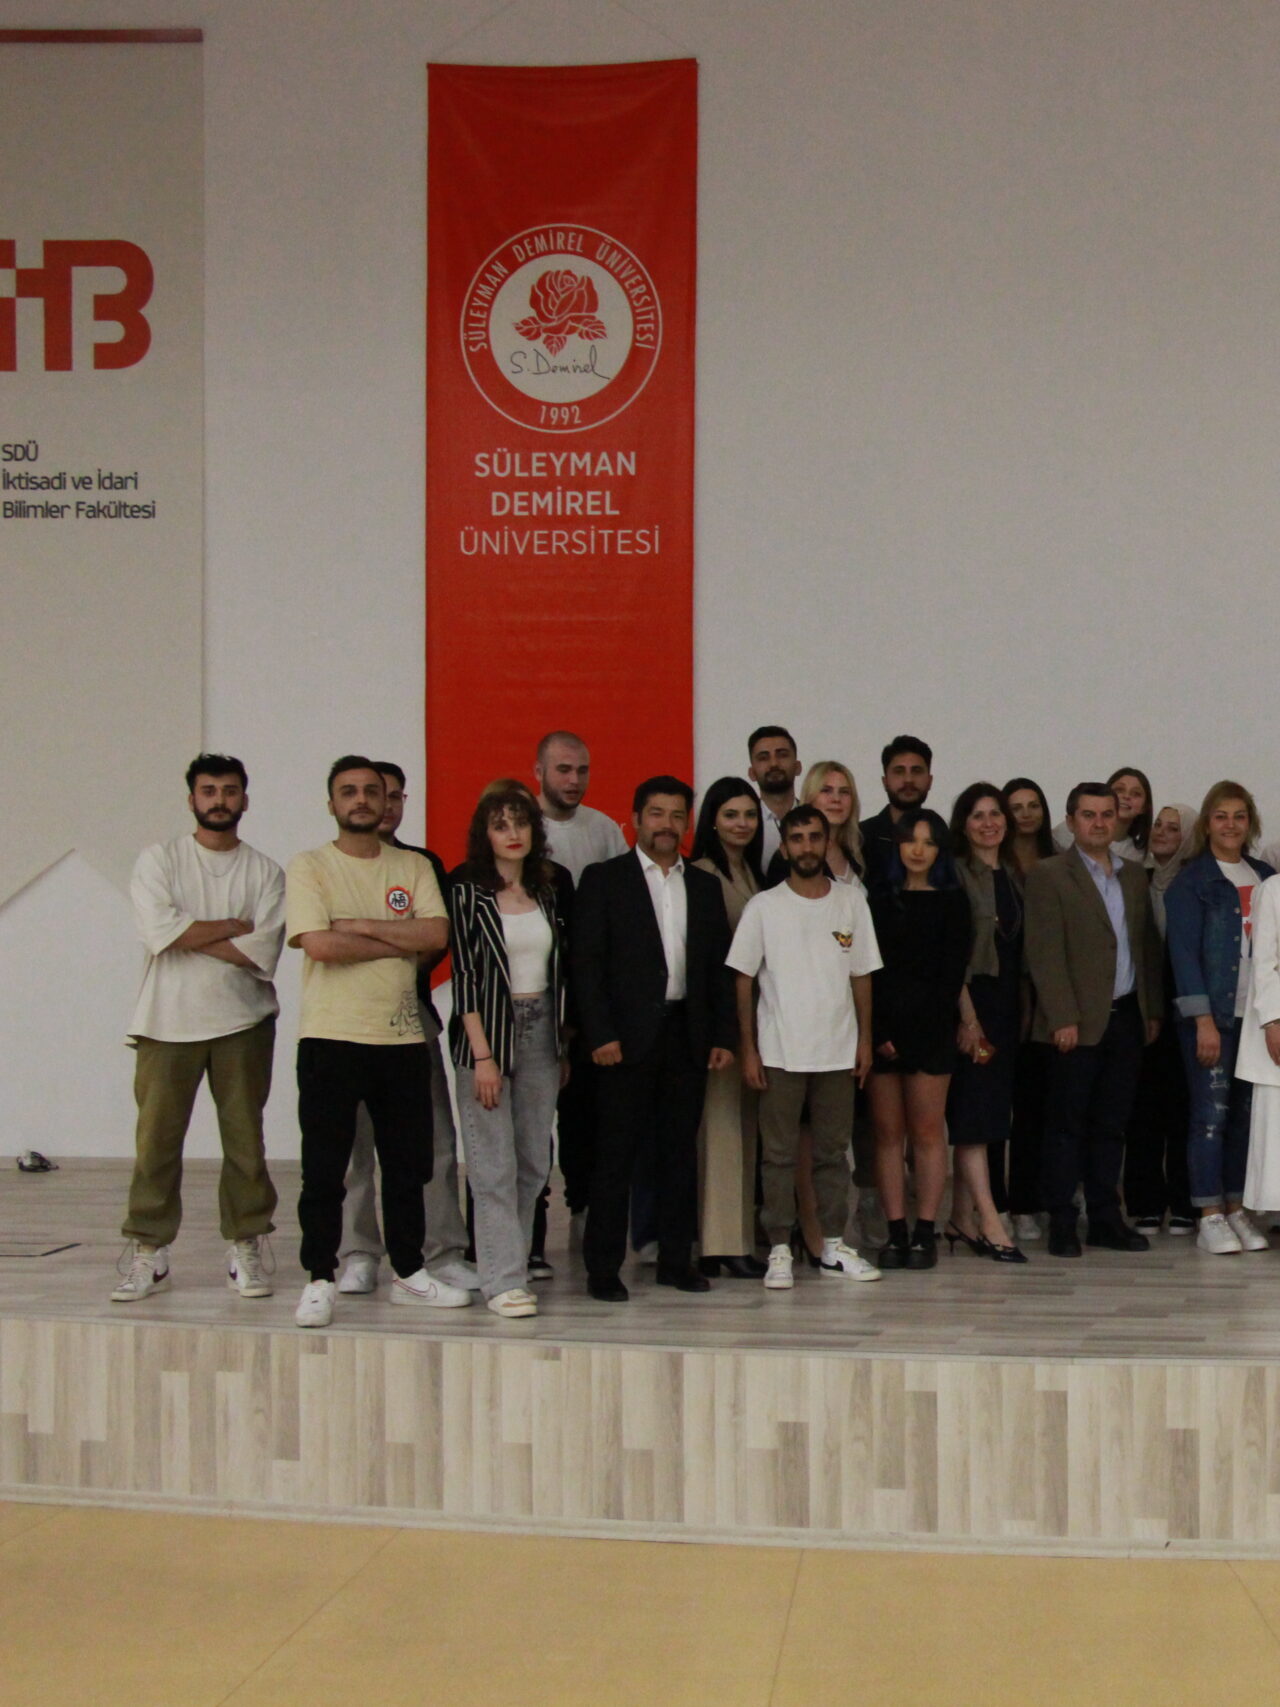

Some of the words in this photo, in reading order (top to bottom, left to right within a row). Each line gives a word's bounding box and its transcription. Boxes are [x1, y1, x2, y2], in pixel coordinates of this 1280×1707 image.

[463, 260, 509, 352] SÜLEYMAN
[512, 229, 584, 260] DEMİREL
[539, 405, 582, 425] 1992
[2, 440, 38, 461] SDÜ
[474, 448, 636, 477] SÜLEYMAN
[2, 468, 66, 490] İktisadi
[71, 475, 92, 490] ve
[97, 468, 138, 490] İdari
[3, 501, 70, 519] Bilimler
[76, 500, 156, 519] Fakültesi
[491, 486, 620, 516] DEMİREL
[460, 526, 660, 555] ÜNİVERSİTESİ
